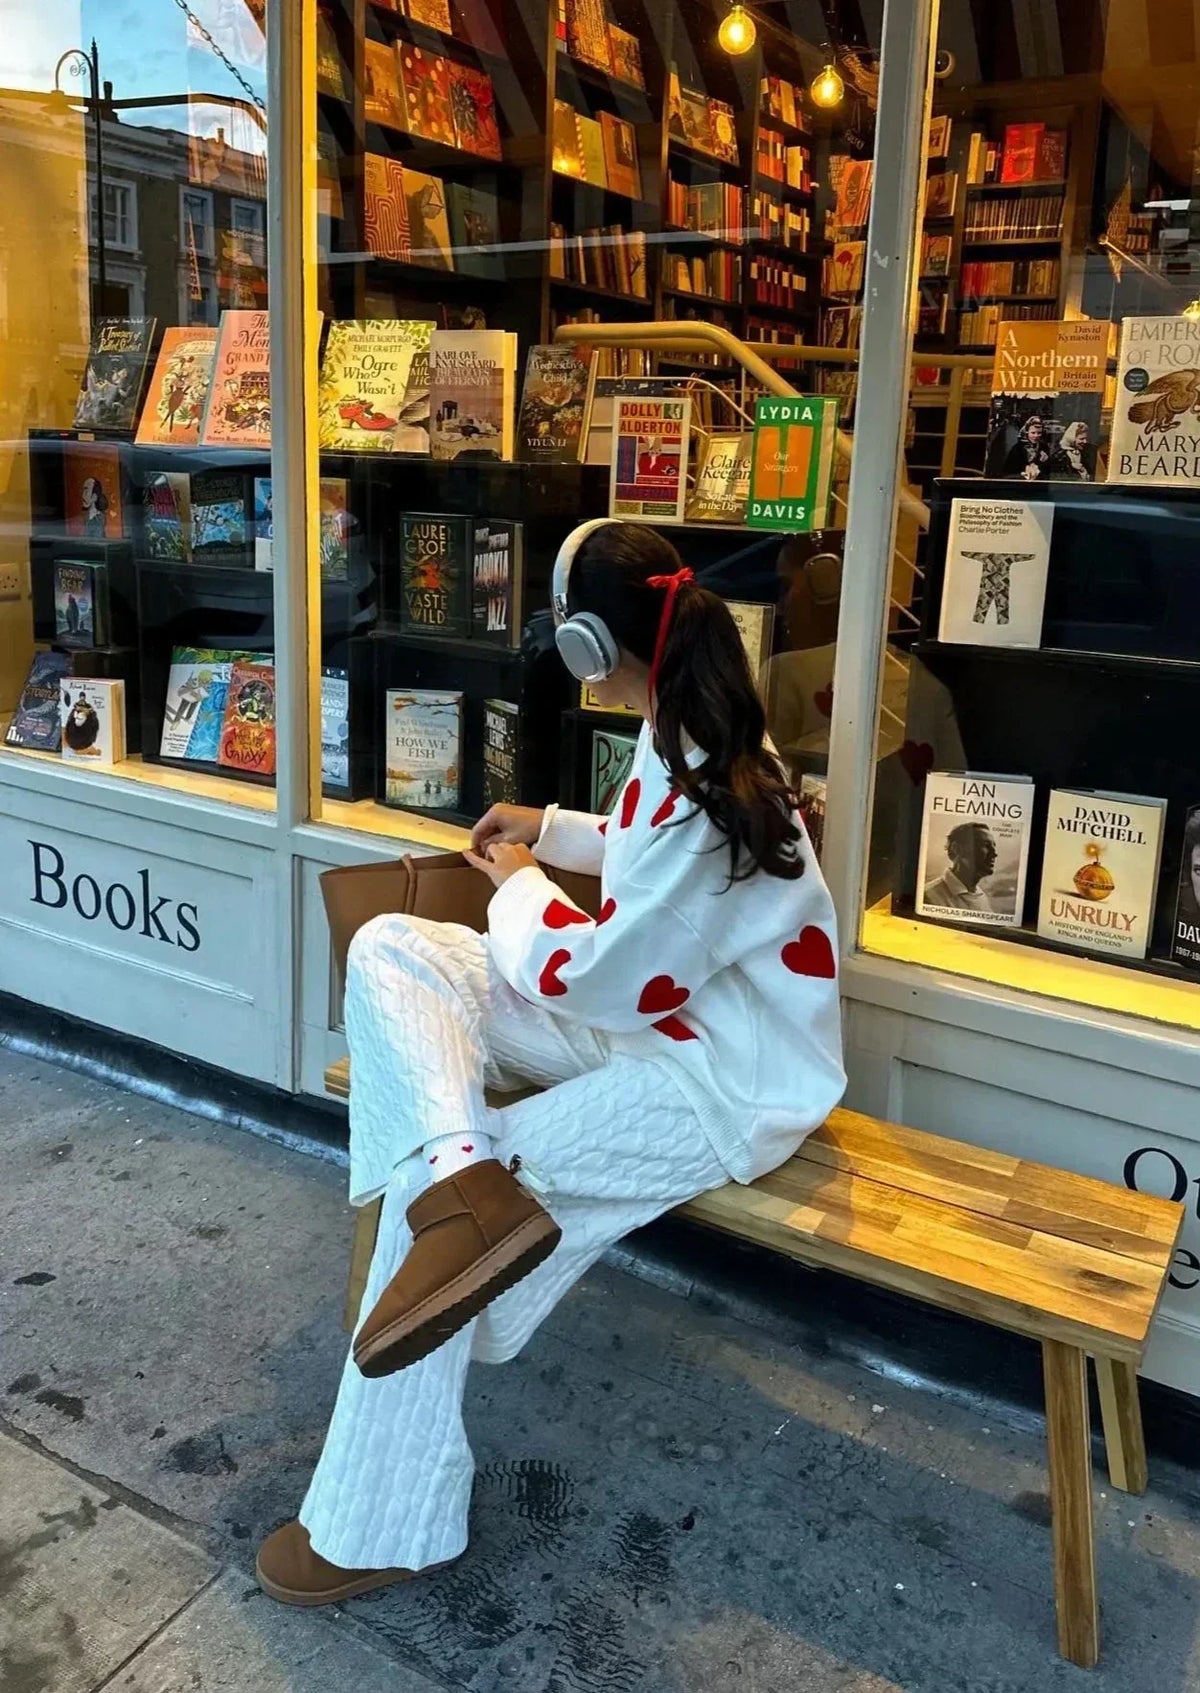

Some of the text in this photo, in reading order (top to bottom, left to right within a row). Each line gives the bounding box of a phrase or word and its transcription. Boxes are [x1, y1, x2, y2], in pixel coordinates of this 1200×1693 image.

[1074, 325, 1102, 333] David
[1129, 322, 1200, 341] EMPER
[348, 334, 376, 342] MICHAEL
[1001, 328, 1018, 347] A
[1058, 333, 1101, 343] Kynaston
[353, 344, 403, 353] EMILY GRAVETT
[435, 350, 477, 360] KARL OVE
[1126, 343, 1200, 367] OF RO
[226, 352, 264, 365] GRAND
[1000, 349, 1099, 369] Northern
[343, 366, 370, 380] Who
[361, 354, 398, 378] Ogre
[543, 373, 567, 383] Child
[998, 370, 1055, 388] Wind
[1063, 371, 1097, 380] Britain
[357, 381, 396, 395] Wasn't
[621, 402, 662, 417] DOLLY
[760, 406, 813, 420] LYDIA
[619, 420, 682, 434] ALDERTON
[527, 437, 567, 447] YIYUN LI
[1134, 434, 1200, 454] MARY
[710, 454, 751, 470] Claire
[773, 451, 789, 462] Our
[702, 465, 751, 483] Keegan
[752, 503, 806, 520] DAVIS
[959, 513, 994, 521] Bloomsbury
[960, 505, 1024, 515] Bring No Clothes
[958, 519, 990, 527] Philosophy
[985, 527, 1010, 535] Porter
[395, 736, 448, 750] HOW WE
[408, 747, 436, 759] FISH
[962, 782, 996, 798] IAN
[933, 796, 1023, 819] FLEMING
[1075, 806, 1131, 828] DAVID
[1056, 817, 1147, 845] MITCHELL
[27, 839, 201, 952] Books
[922, 905, 1014, 923] NICHOLAS SHAKESPEARE
[1050, 898, 1138, 932] UNRULY
[1054, 920, 1084, 933] HISTORY
[1094, 930, 1134, 943] ENGLAND'S
[1057, 929, 1123, 948] KINGS AND QUEENS
